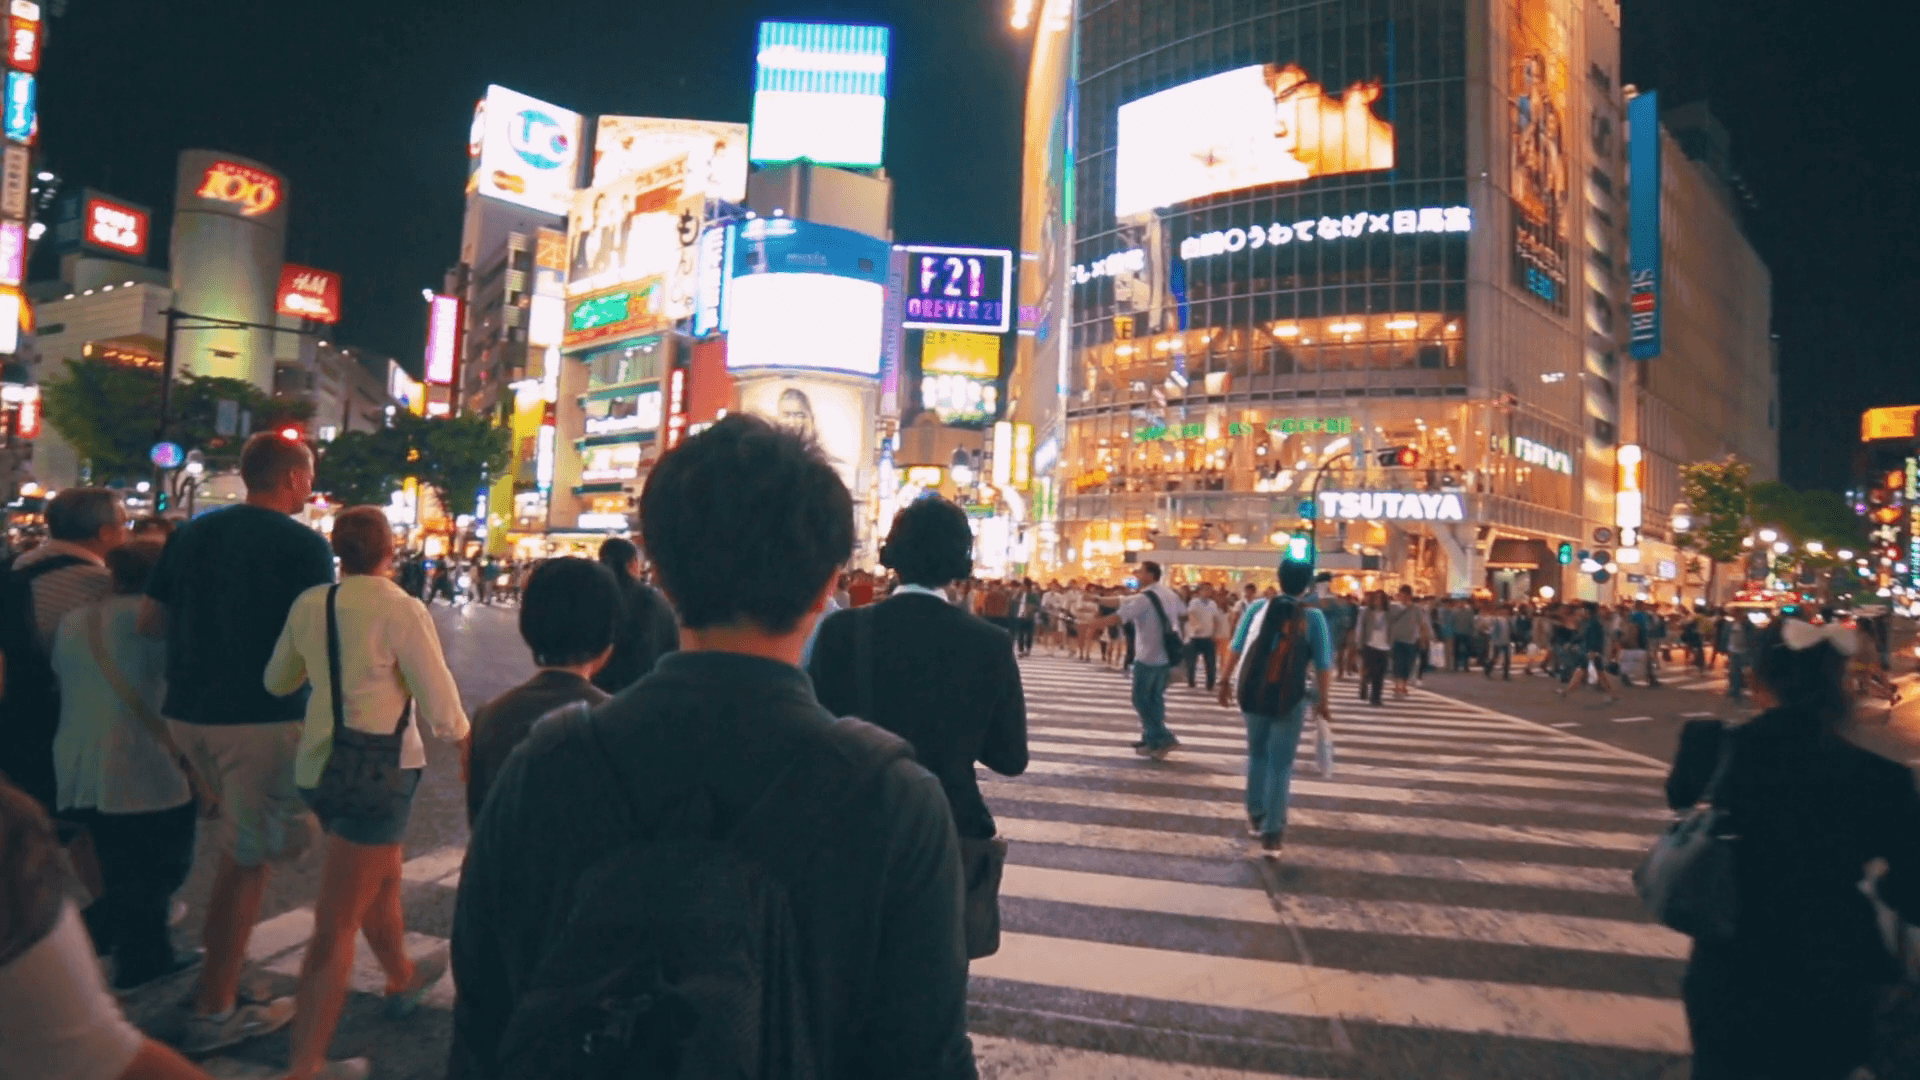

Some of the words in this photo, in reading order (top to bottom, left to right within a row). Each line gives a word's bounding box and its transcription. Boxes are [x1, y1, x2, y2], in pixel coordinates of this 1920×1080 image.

[196, 170, 277, 216] 109
[921, 256, 983, 297] F21
[1318, 492, 1463, 520] TSUTAYA
